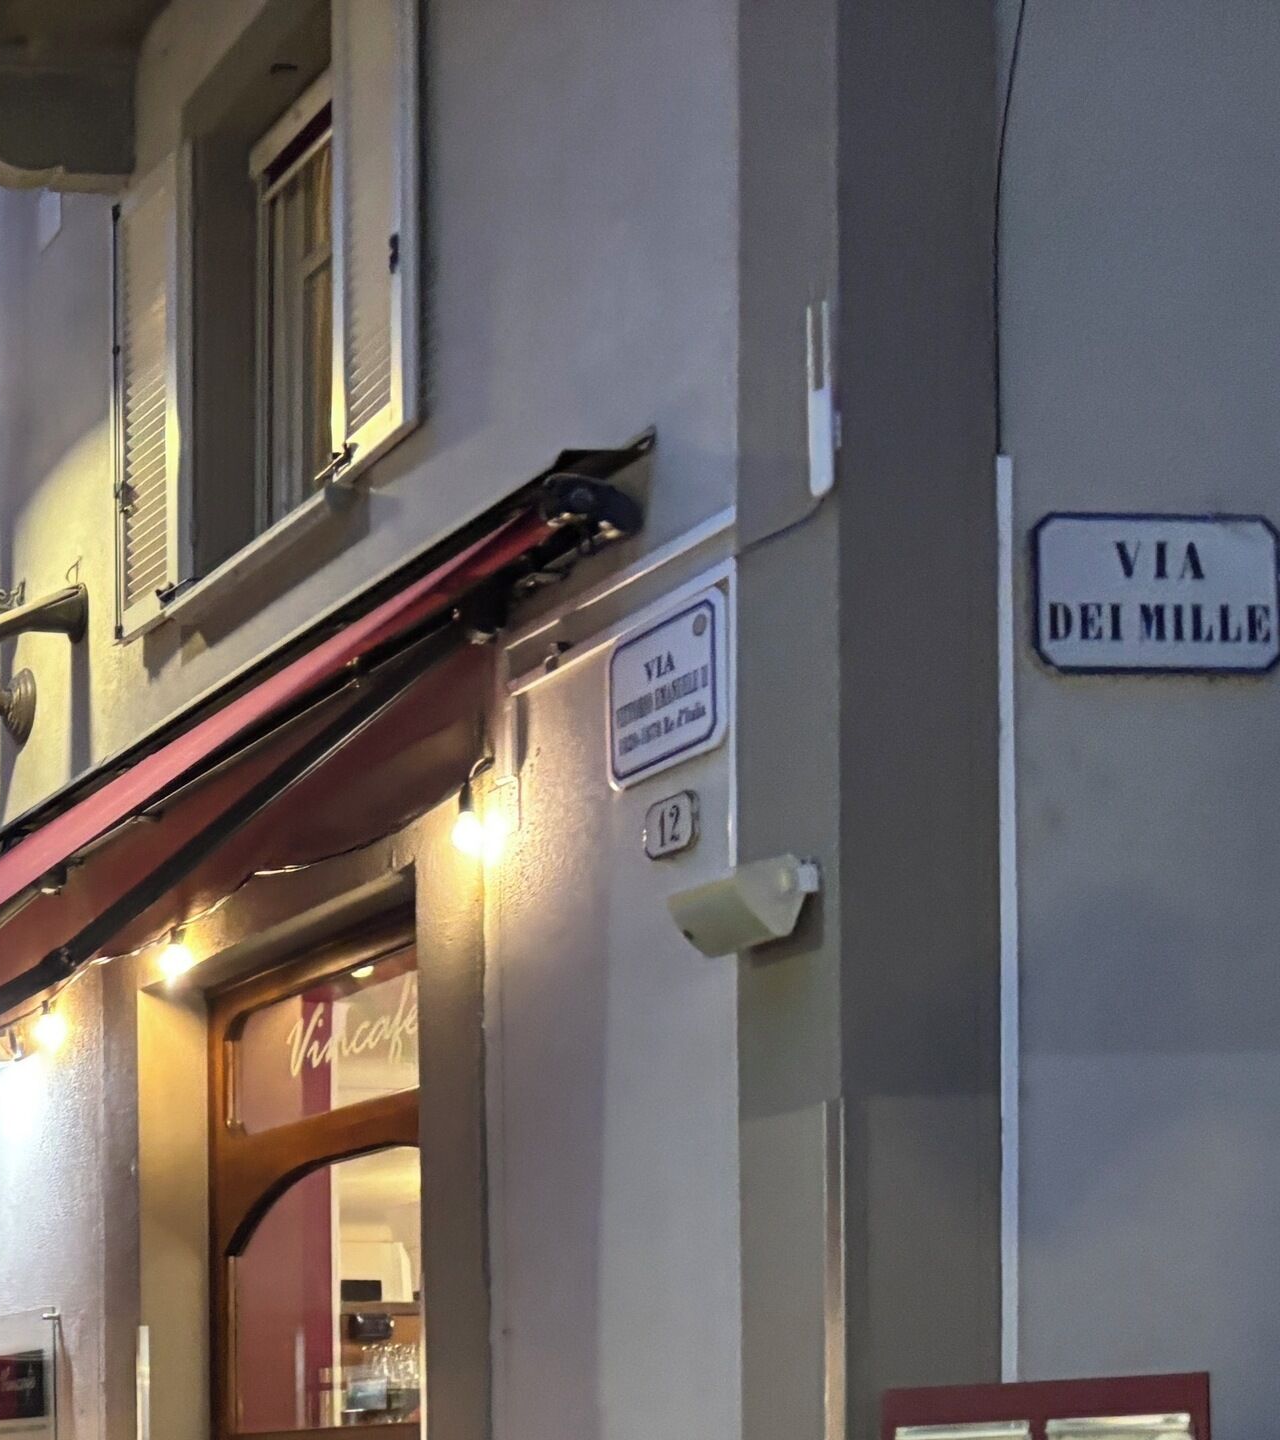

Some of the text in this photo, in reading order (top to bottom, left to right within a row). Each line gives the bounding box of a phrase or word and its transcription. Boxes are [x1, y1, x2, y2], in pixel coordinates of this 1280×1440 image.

[1114, 540, 1206, 580] VIA
[1048, 602, 1272, 644] DEI MILLE
[643, 650, 676, 682] VIA
[658, 803, 681, 848] 12
